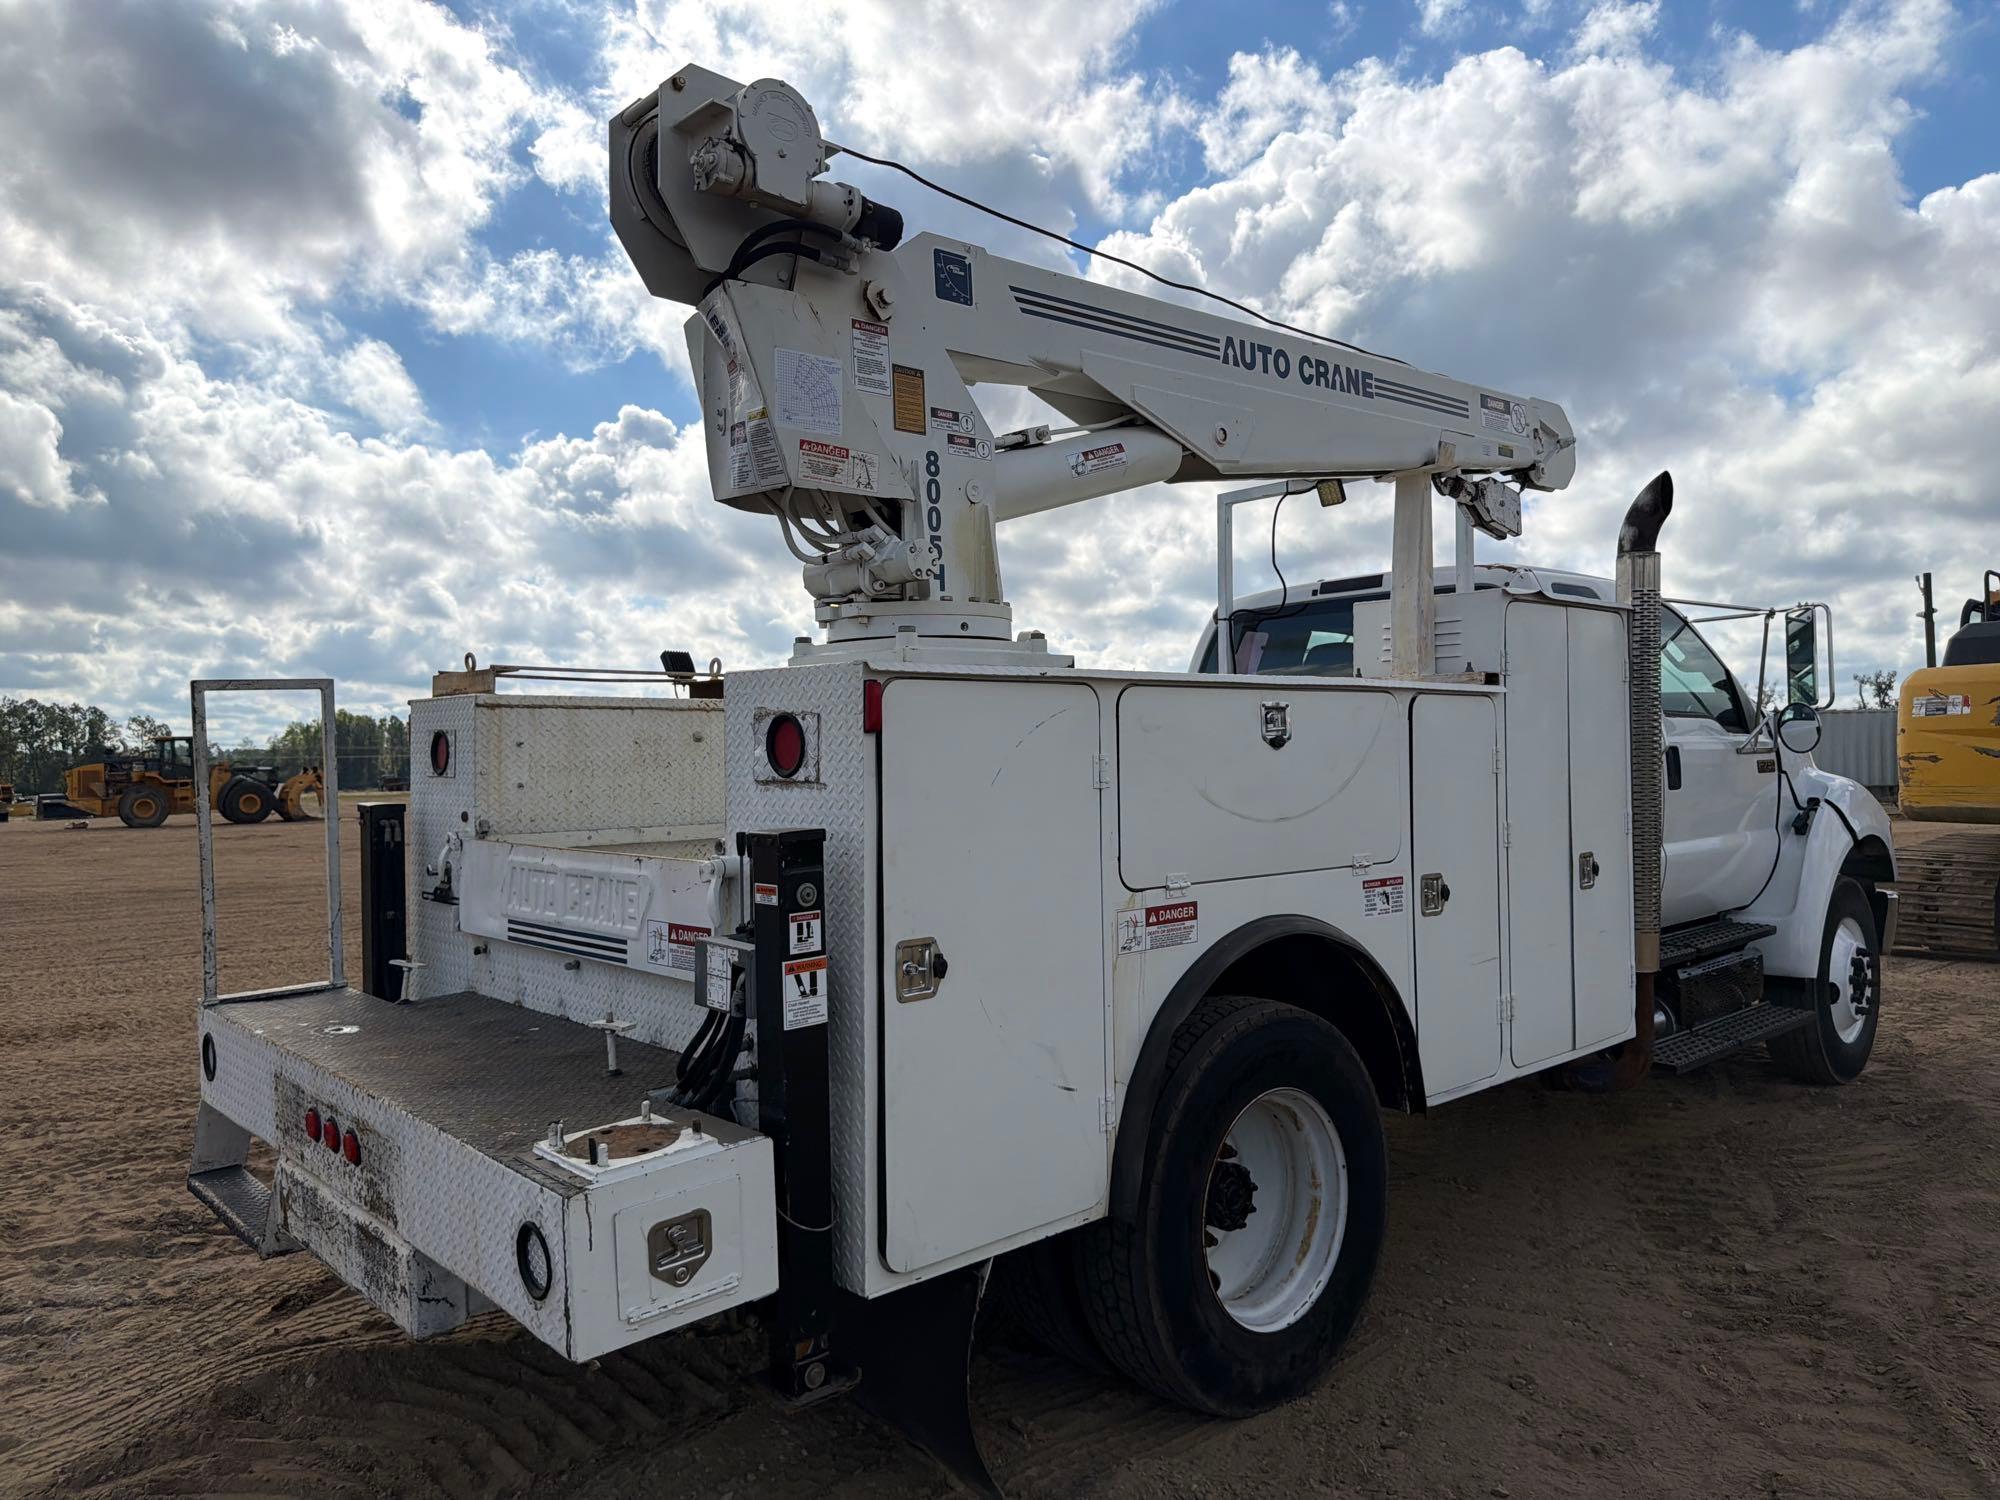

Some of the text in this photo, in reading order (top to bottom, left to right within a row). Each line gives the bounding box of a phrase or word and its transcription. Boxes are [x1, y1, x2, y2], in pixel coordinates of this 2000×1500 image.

[860, 322, 886, 335] DANGER
[1220, 336, 1376, 399] AUTO CRANE
[1487, 398, 1505, 410] DANGER
[937, 410, 953, 419] DANGER
[954, 436, 970, 445] DANGER
[810, 442, 847, 457] DANGER
[1093, 445, 1120, 457] DANGER
[1159, 906, 1195, 922] DANGER
[796, 960, 823, 971] WARNING
